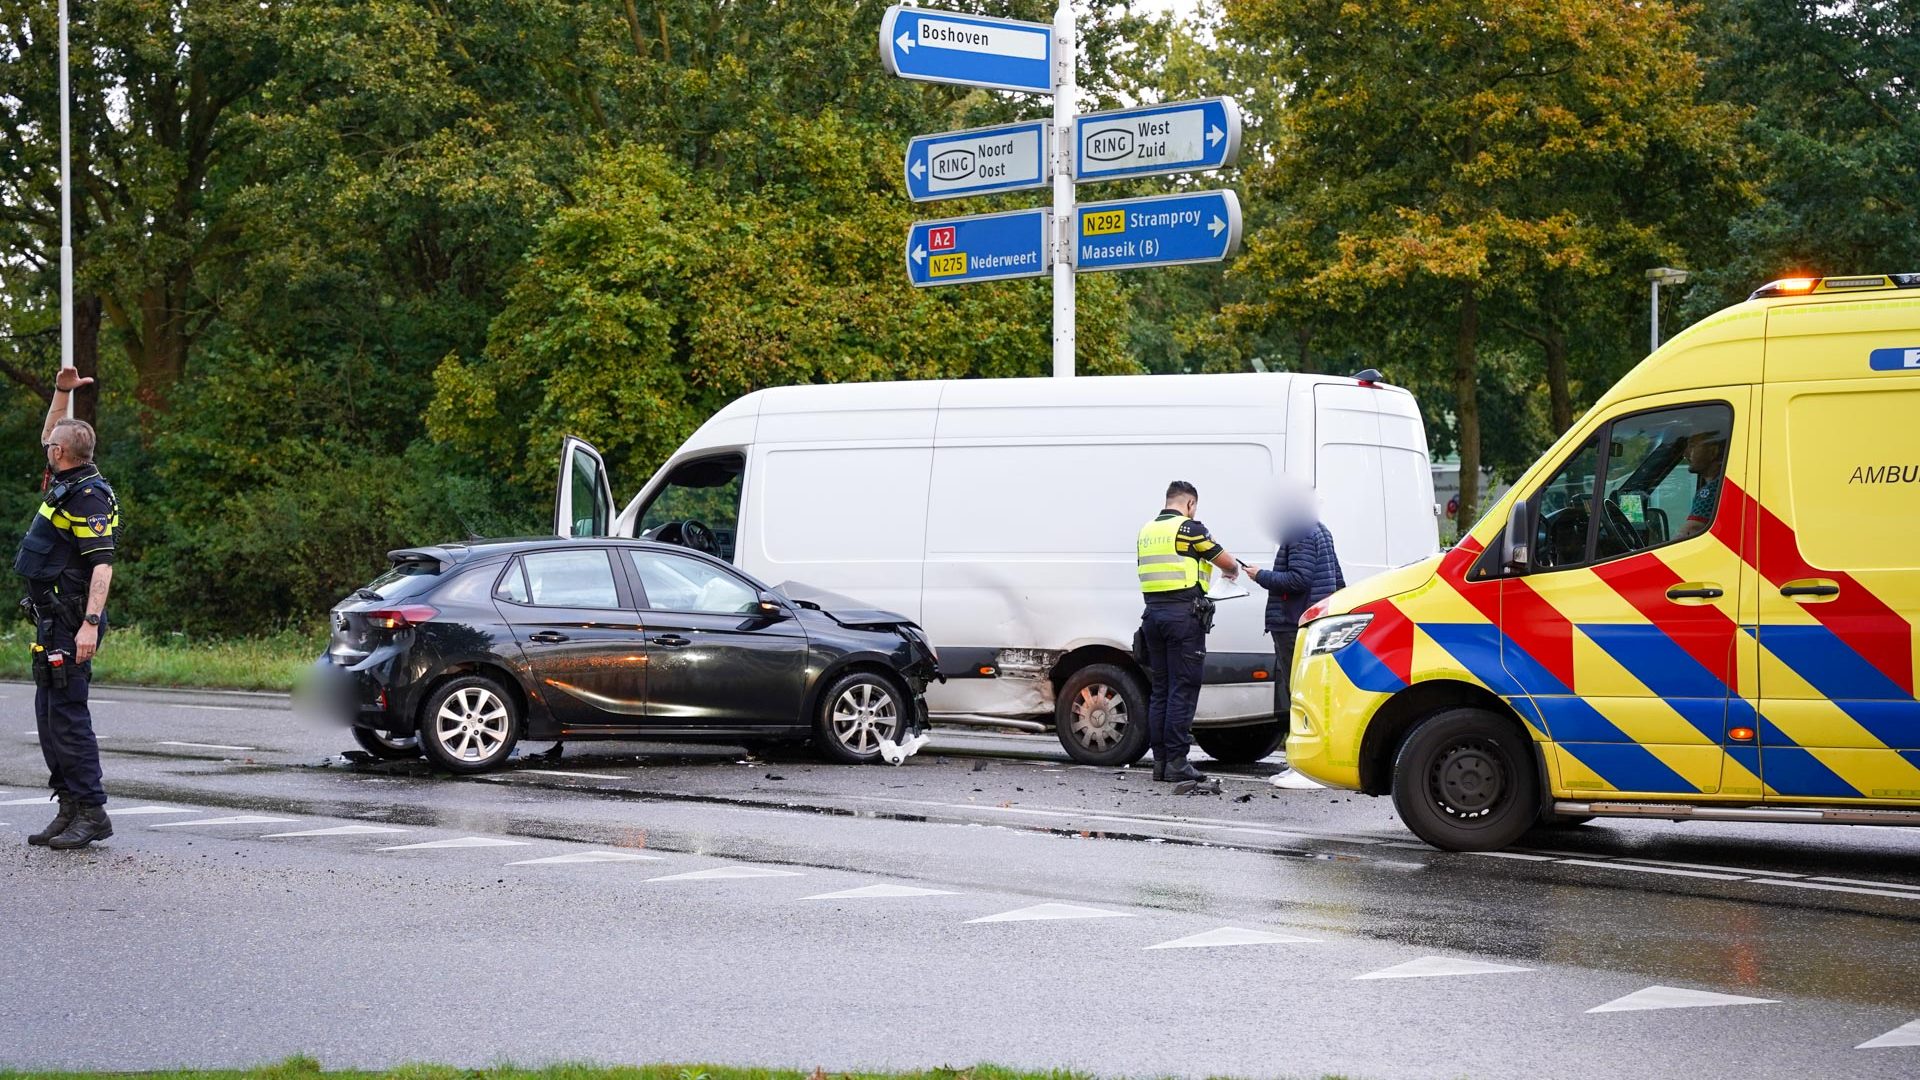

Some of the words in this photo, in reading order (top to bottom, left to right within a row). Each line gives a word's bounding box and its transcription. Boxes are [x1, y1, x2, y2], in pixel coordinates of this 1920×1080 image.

[922, 24, 989, 46] Boshoven
[1138, 121, 1170, 137] West
[978, 140, 1014, 158] Noord
[1094, 137, 1126, 153] RING
[1138, 142, 1166, 158] Zuid
[939, 157, 968, 173] RING
[979, 163, 1006, 178] Oost
[1087, 214, 1121, 232] N292
[1130, 209, 1201, 229] Stramproy
[933, 231, 951, 246] A2
[1082, 241, 1135, 260] Maaseik
[1139, 238, 1160, 257] (B)
[933, 256, 963, 272] N275
[971, 251, 1037, 269] Nederweert
[1849, 465, 1920, 485] AMBU
